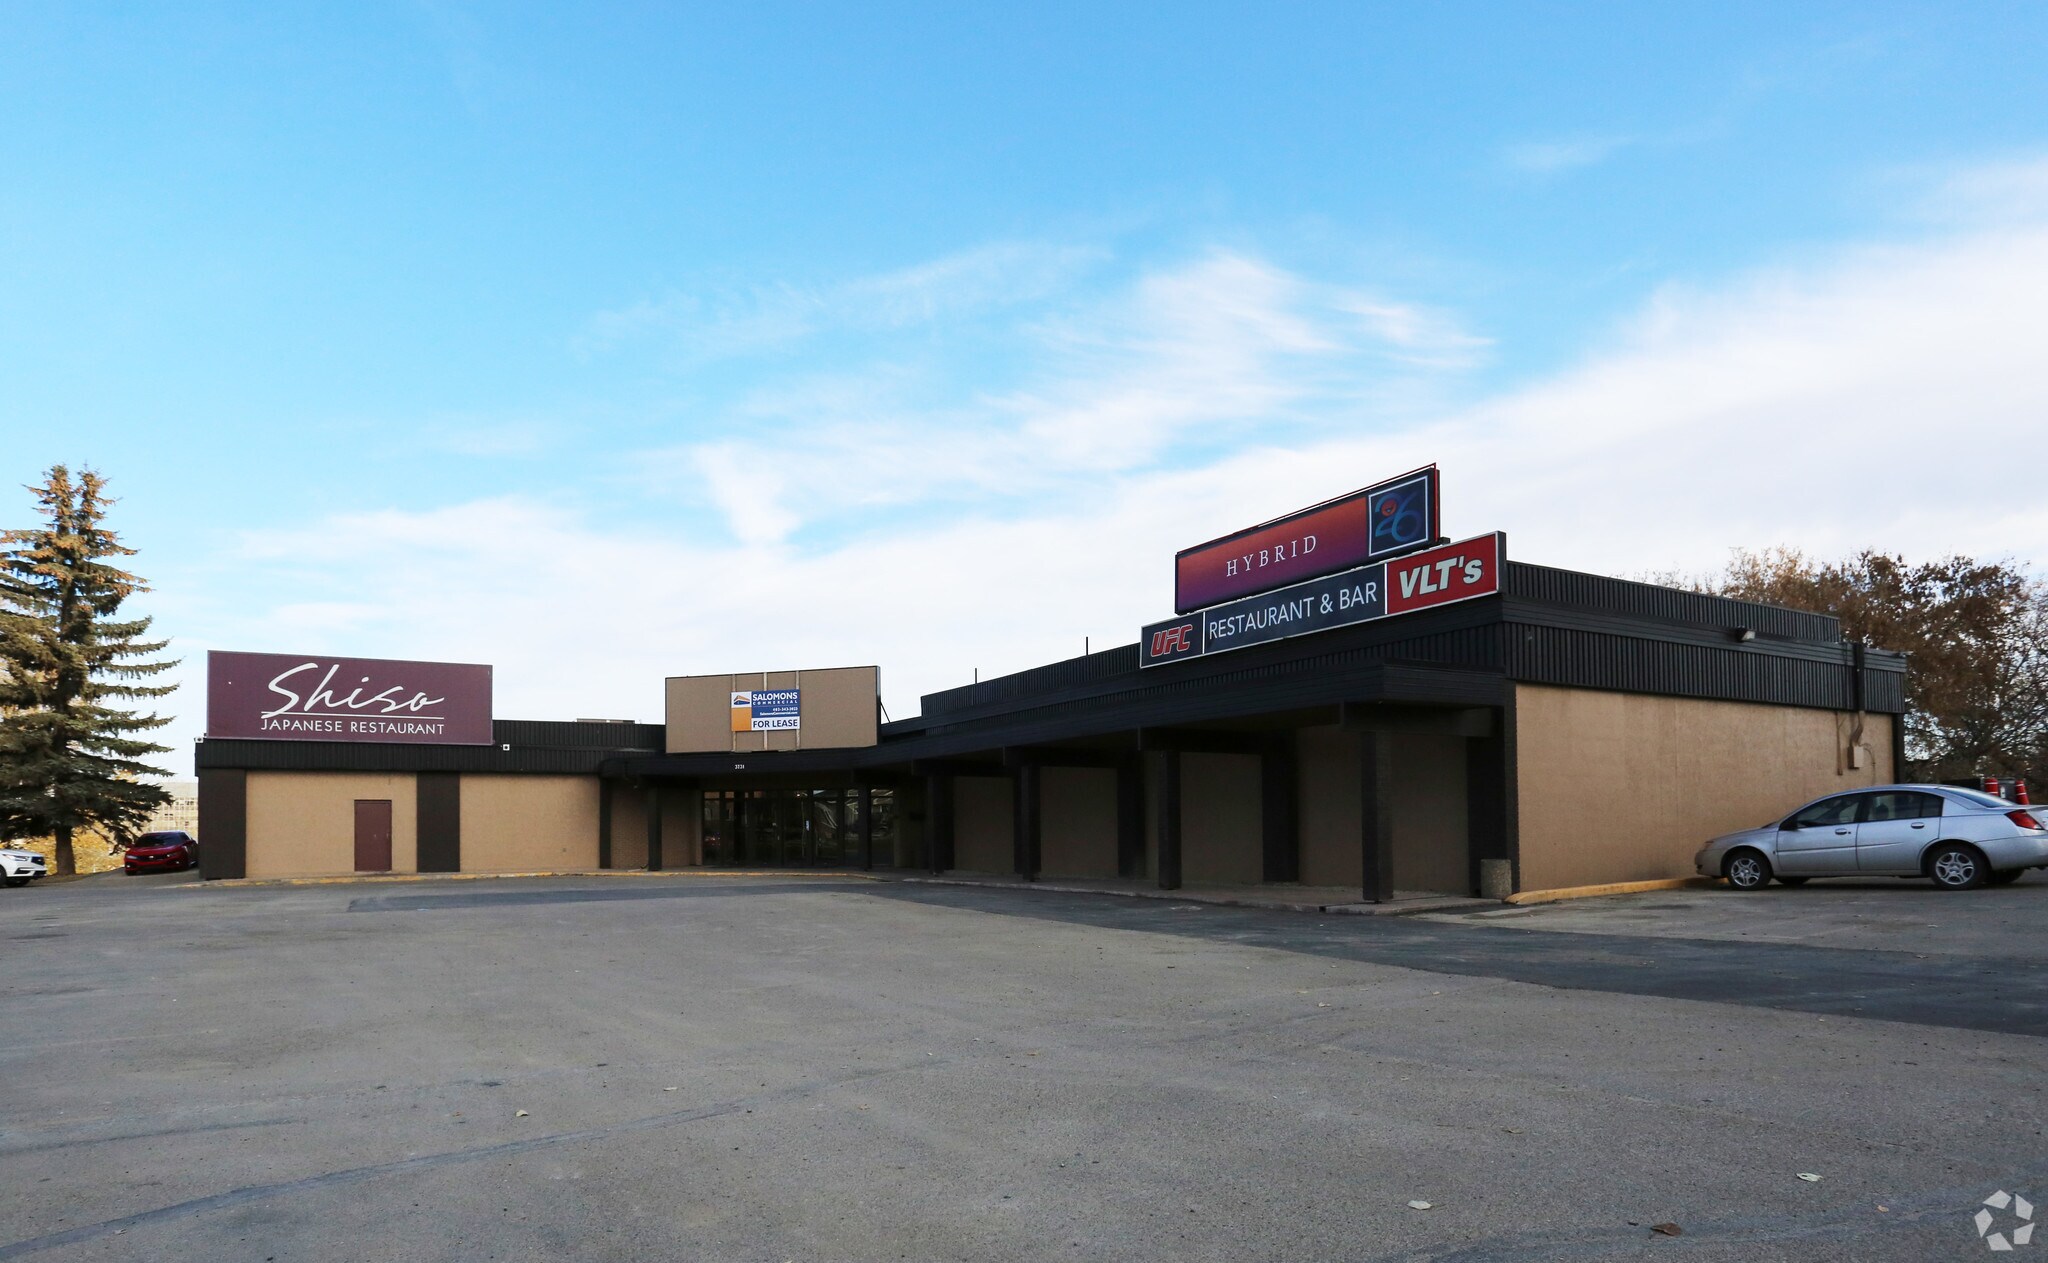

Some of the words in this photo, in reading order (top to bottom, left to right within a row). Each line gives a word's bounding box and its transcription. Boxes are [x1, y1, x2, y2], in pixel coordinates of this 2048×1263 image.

[1226, 535, 1317, 577] HYBRID
[1399, 556, 1483, 599] VLT's
[1209, 597, 1315, 640] RESTAURANT
[1320, 593, 1334, 615] &
[1339, 581, 1377, 611] BAR
[1151, 624, 1193, 657] UFC
[261, 662, 445, 719] Shiso
[752, 692, 798, 701] SALOMONS
[261, 718, 343, 732] JAPANESE
[350, 720, 445, 735] RESTAURANT
[753, 720, 770, 728] FOR
[772, 719, 798, 728] LEASE
